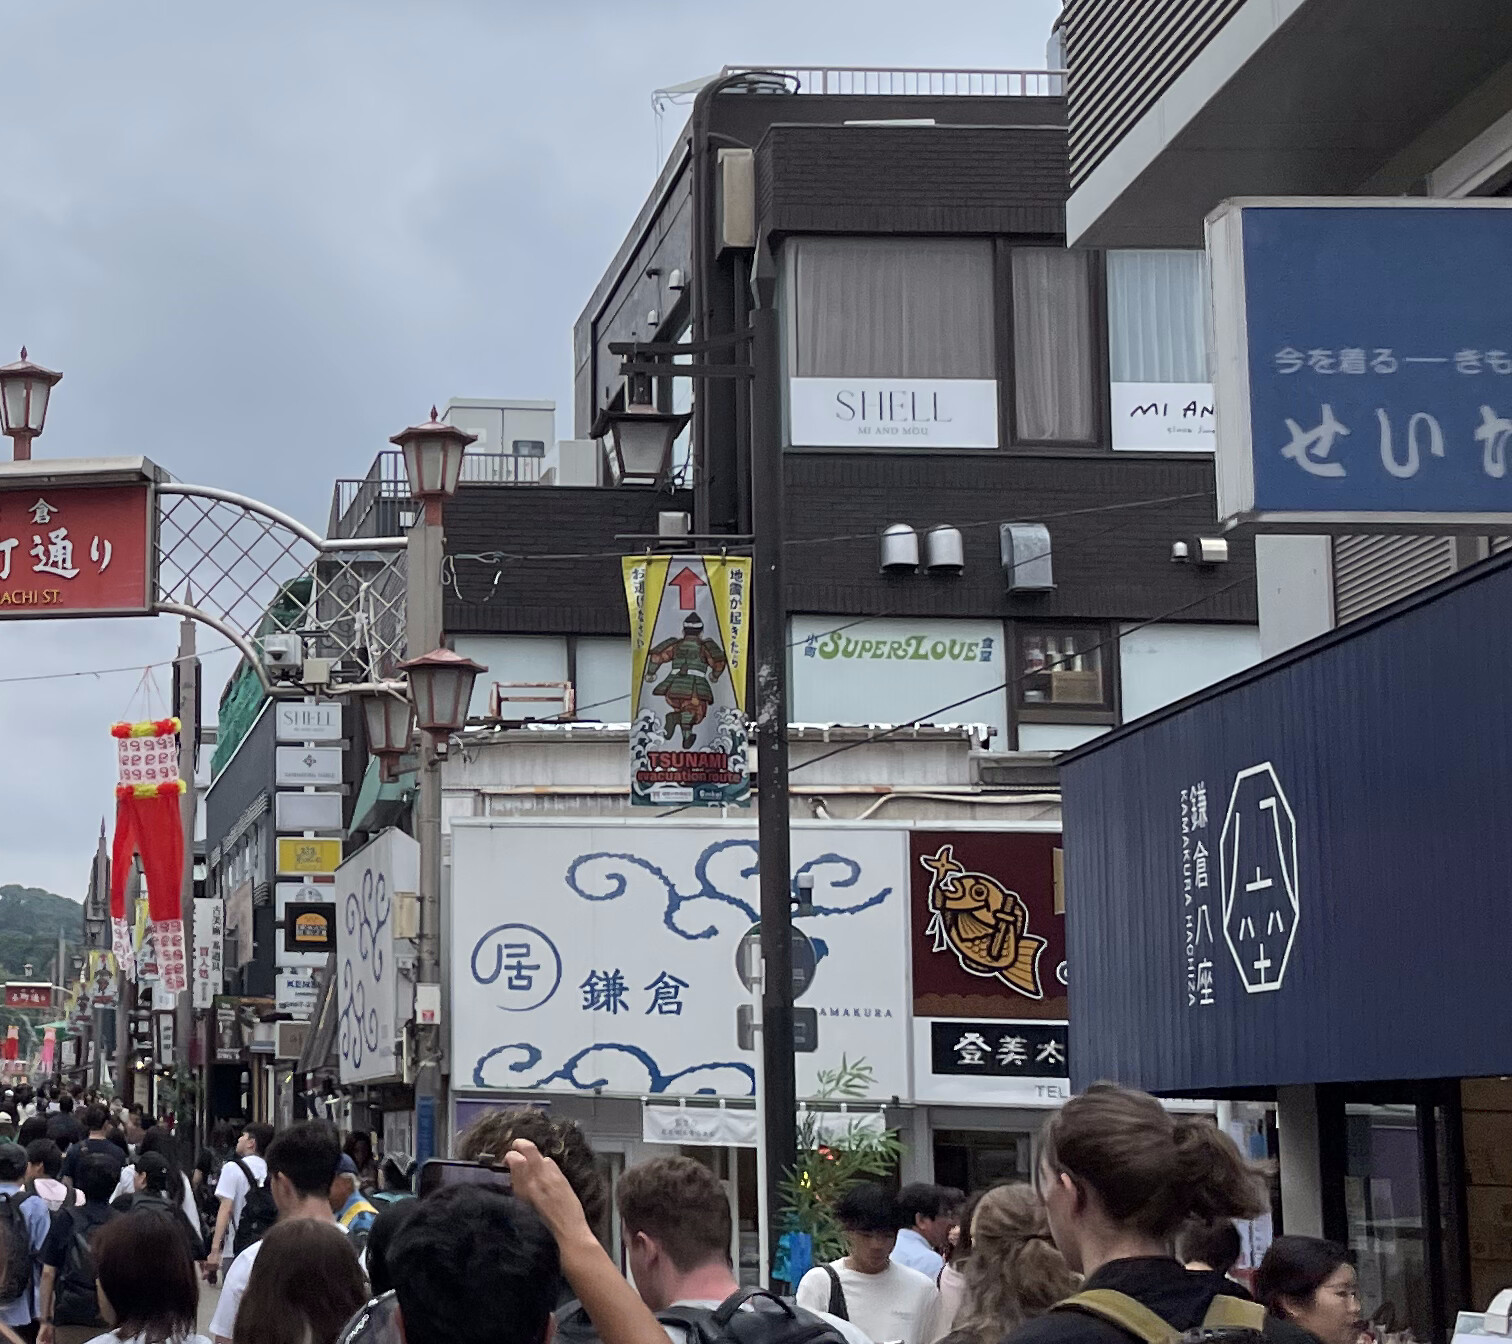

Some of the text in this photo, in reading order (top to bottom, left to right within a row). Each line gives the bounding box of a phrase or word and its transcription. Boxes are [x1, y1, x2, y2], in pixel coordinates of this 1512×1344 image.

[835, 389, 953, 423] SHELL
[1129, 402, 1169, 418] MI
[857, 426, 929, 437] MI AND MOU
[42, 588, 64, 604] ST.
[648, 751, 727, 769] TSUNAMI
[708, 772, 741, 784] route
[1179, 789, 1193, 907] KAMAKURA
[1189, 780, 1215, 1006] 鎌倉八座
[578, 967, 690, 1017] 鎌倉
[1034, 1084, 1067, 1099] TEL
